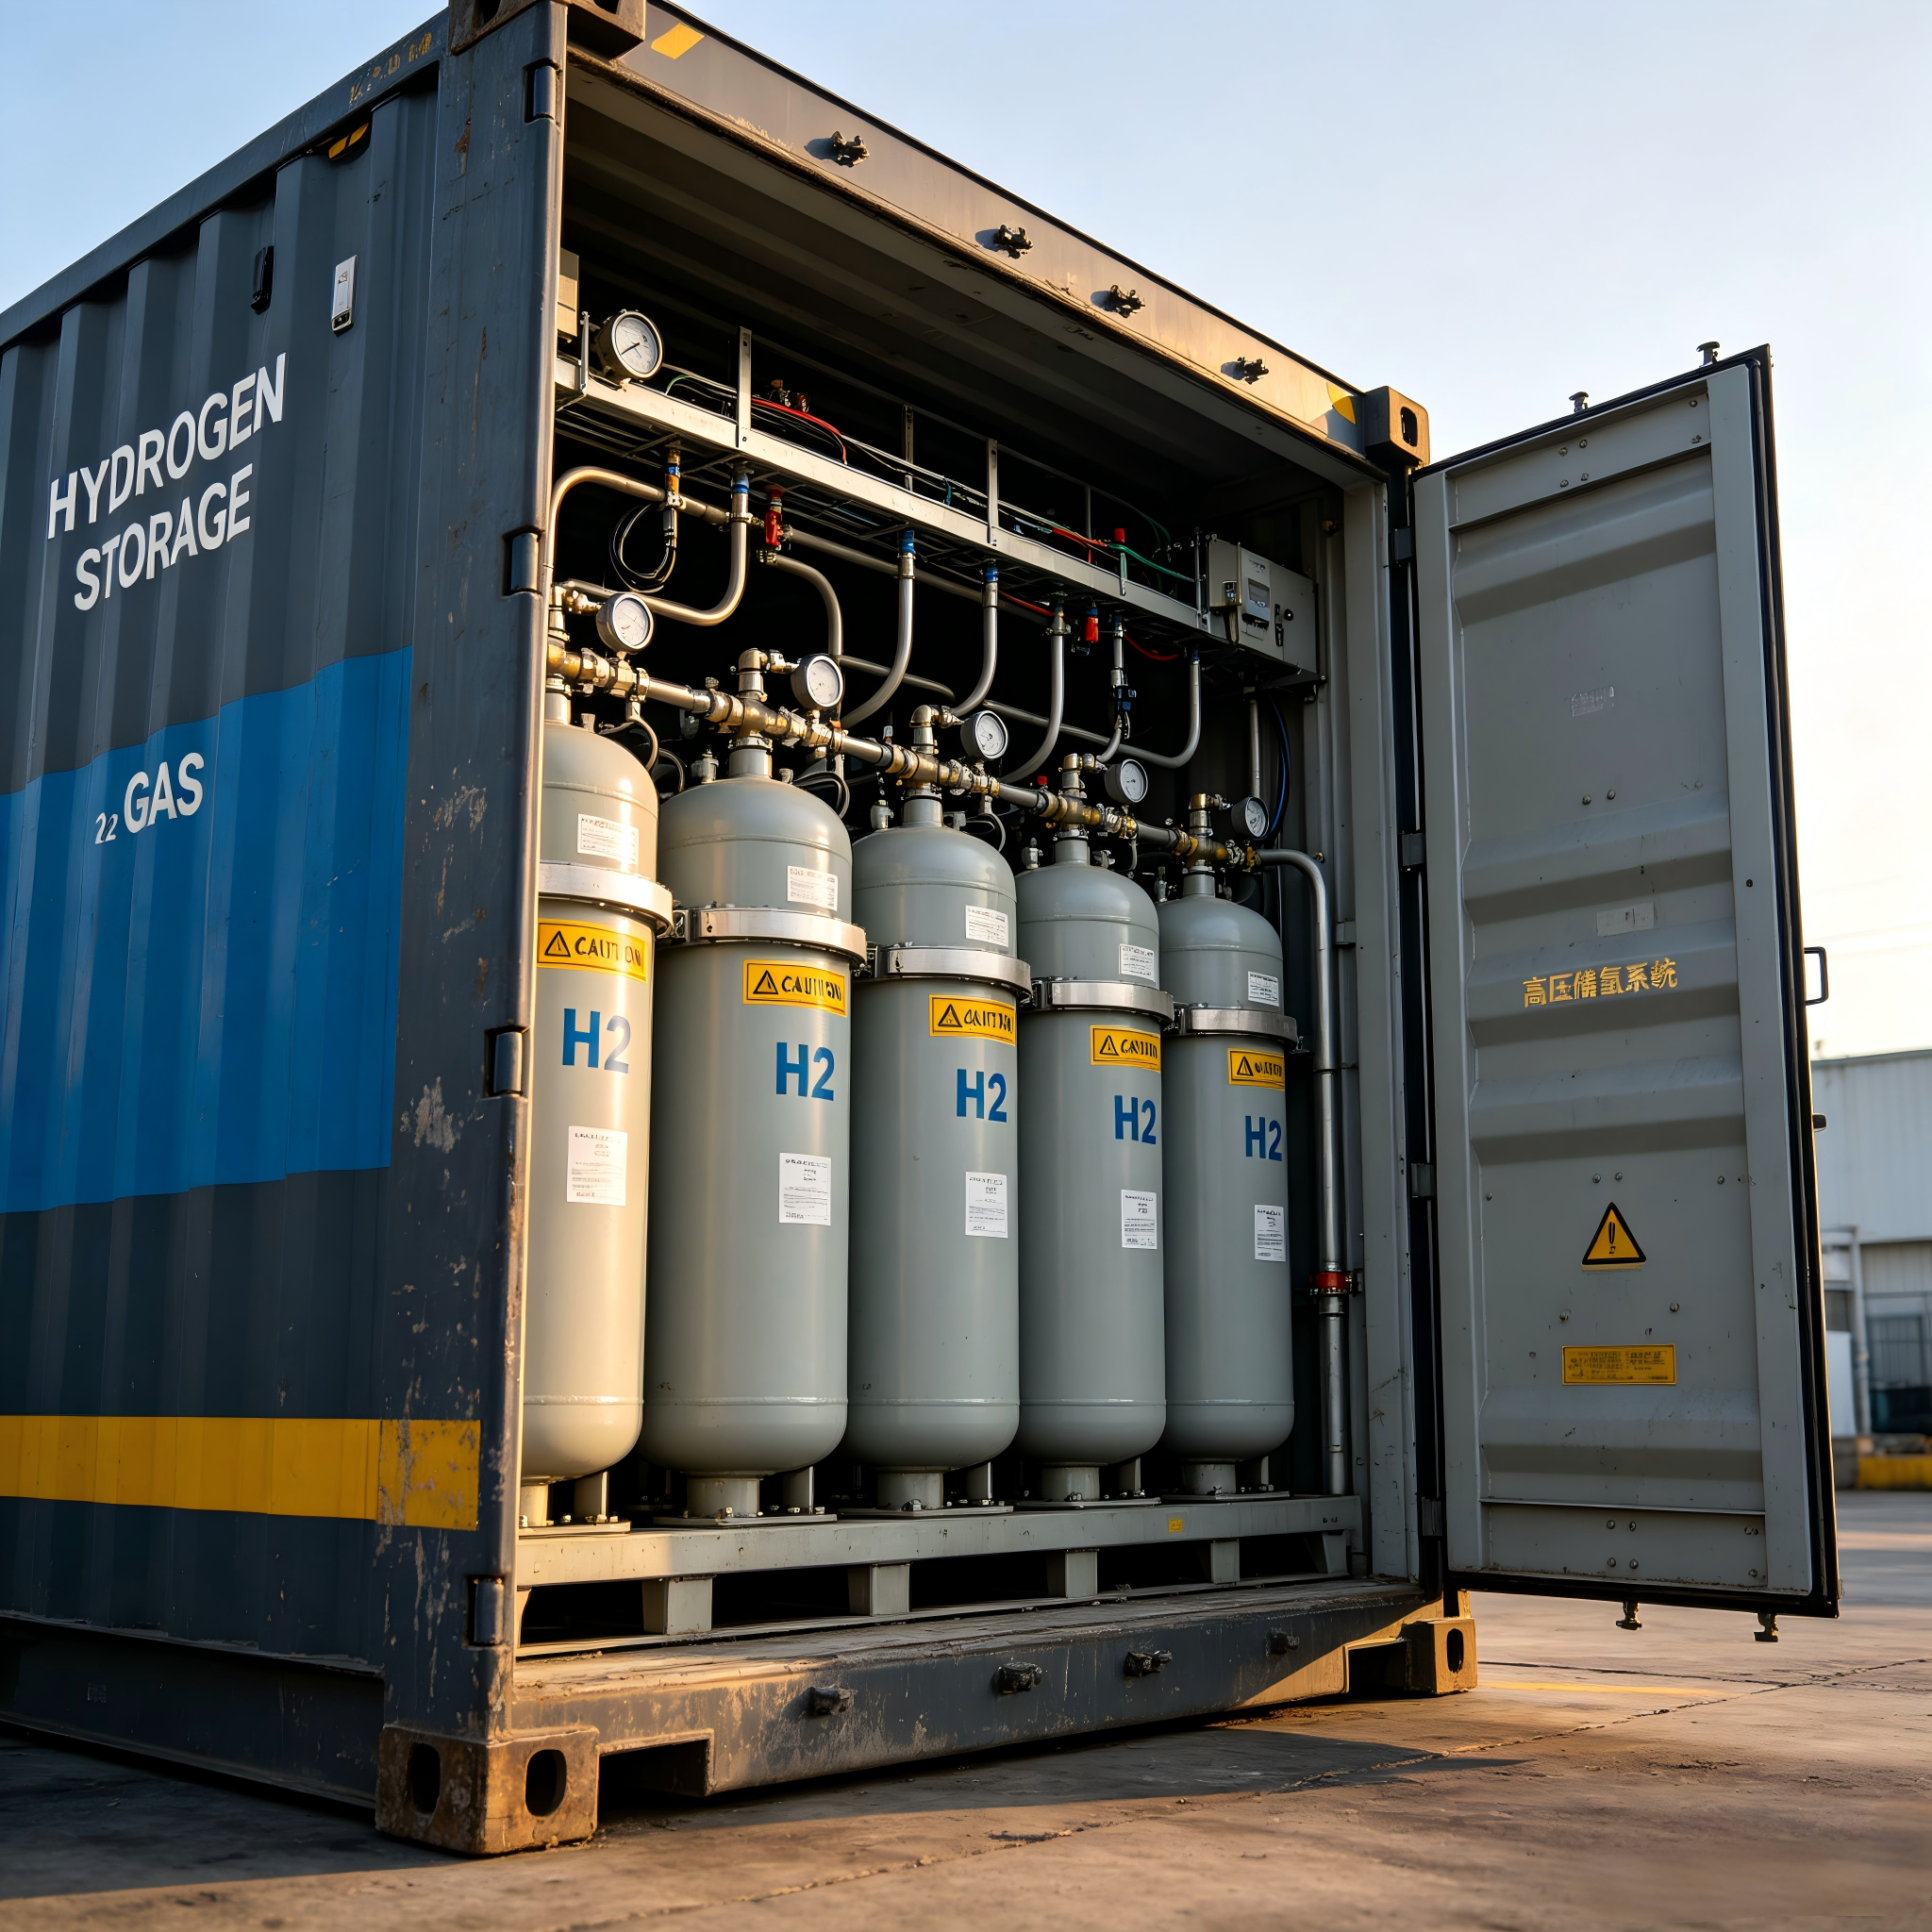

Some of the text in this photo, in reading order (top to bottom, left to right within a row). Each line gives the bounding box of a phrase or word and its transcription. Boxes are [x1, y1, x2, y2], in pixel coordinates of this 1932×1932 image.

[47, 352, 286, 539] HYDROGEN
[75, 463, 253, 610] STORAGE
[124, 752, 205, 834] GAS
[575, 936, 641, 966] CAUTON
[561, 1008, 630, 1074] H2
[775, 1041, 835, 1102] H2
[956, 1068, 1008, 1123] H2
[1114, 1094, 1157, 1145] H2
[1245, 1115, 1283, 1161] H2
